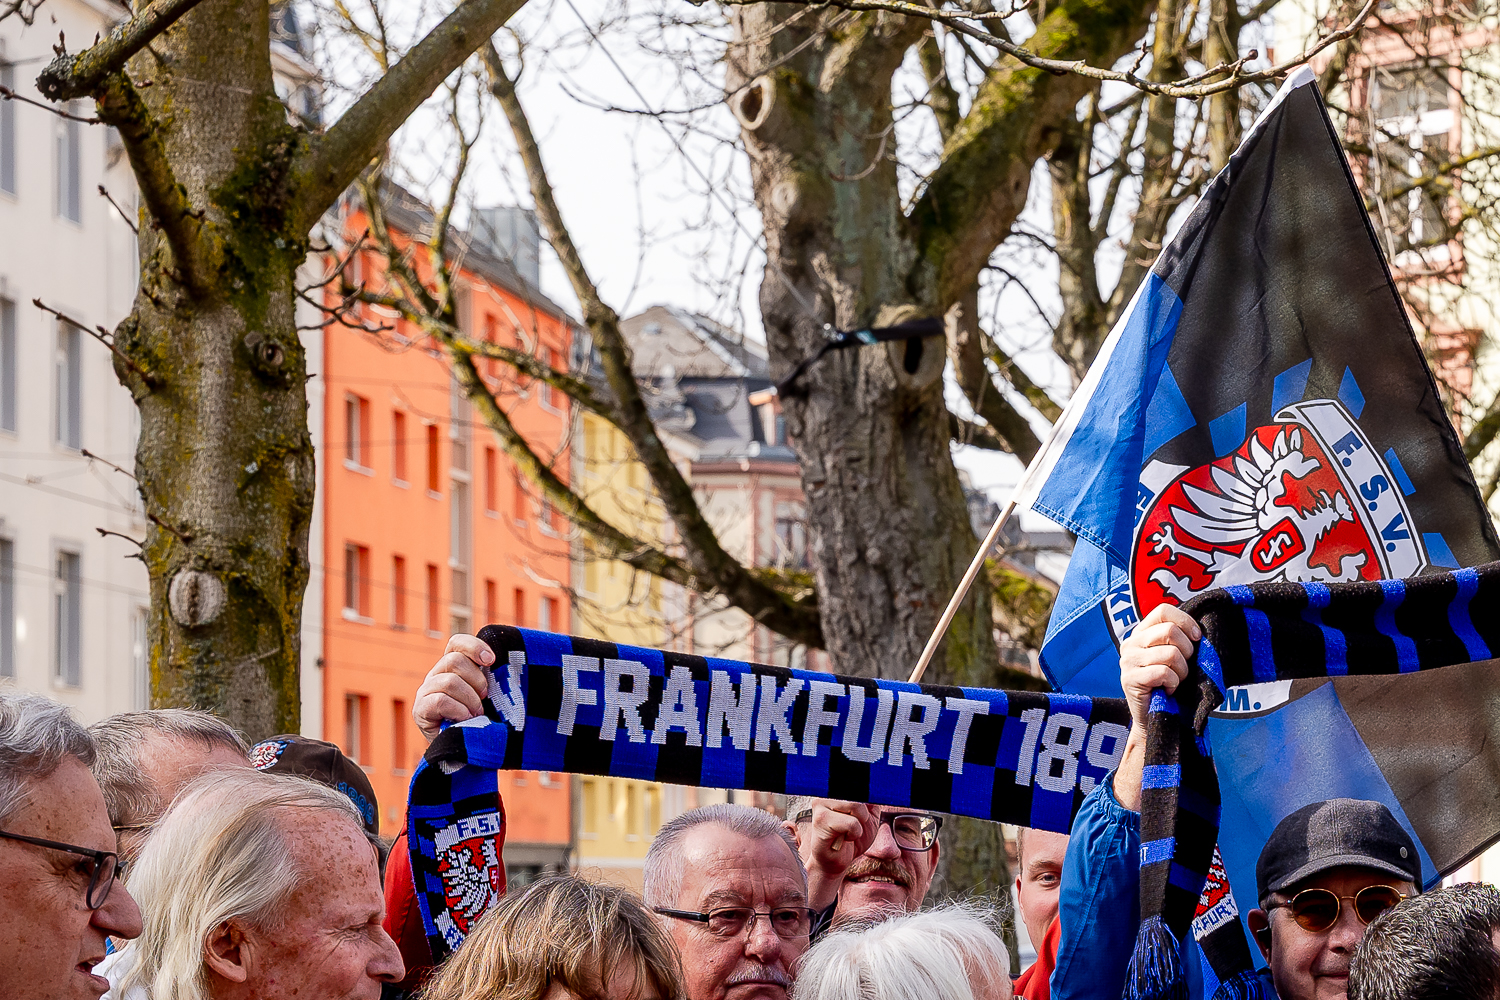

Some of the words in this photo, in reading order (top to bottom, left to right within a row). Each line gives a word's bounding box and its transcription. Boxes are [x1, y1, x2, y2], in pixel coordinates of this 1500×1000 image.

[556, 653, 991, 775] FRANKFURT
[1014, 707, 1130, 796] 189
[456, 816, 500, 838] F.S.
